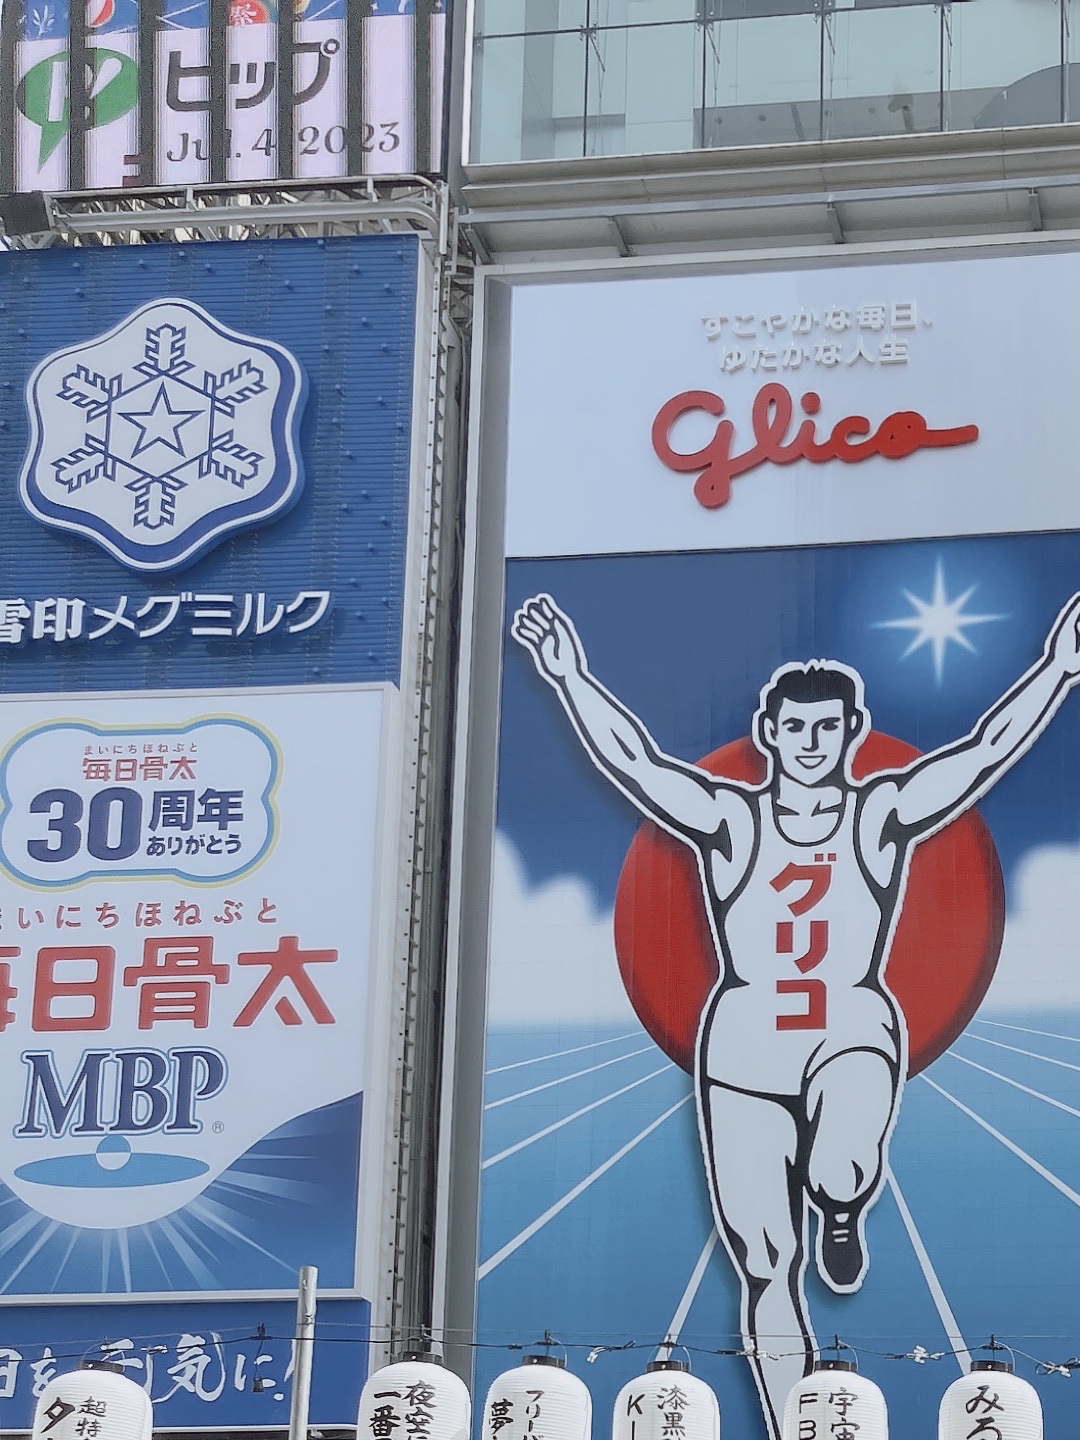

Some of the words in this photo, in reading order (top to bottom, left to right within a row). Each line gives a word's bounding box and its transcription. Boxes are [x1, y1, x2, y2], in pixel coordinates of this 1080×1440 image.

[718, 335, 909, 373] ゆたかな人生
[651, 382, 980, 509] Glico
[0, 591, 331, 643] 雪印メグミルク
[82, 756, 198, 782] 毎日骨太
[146, 834, 242, 856] ありがとう
[0, 898, 277, 929] いにちほねぶと
[769, 852, 837, 1031] グリコ
[14, 1047, 229, 1137] MBP
